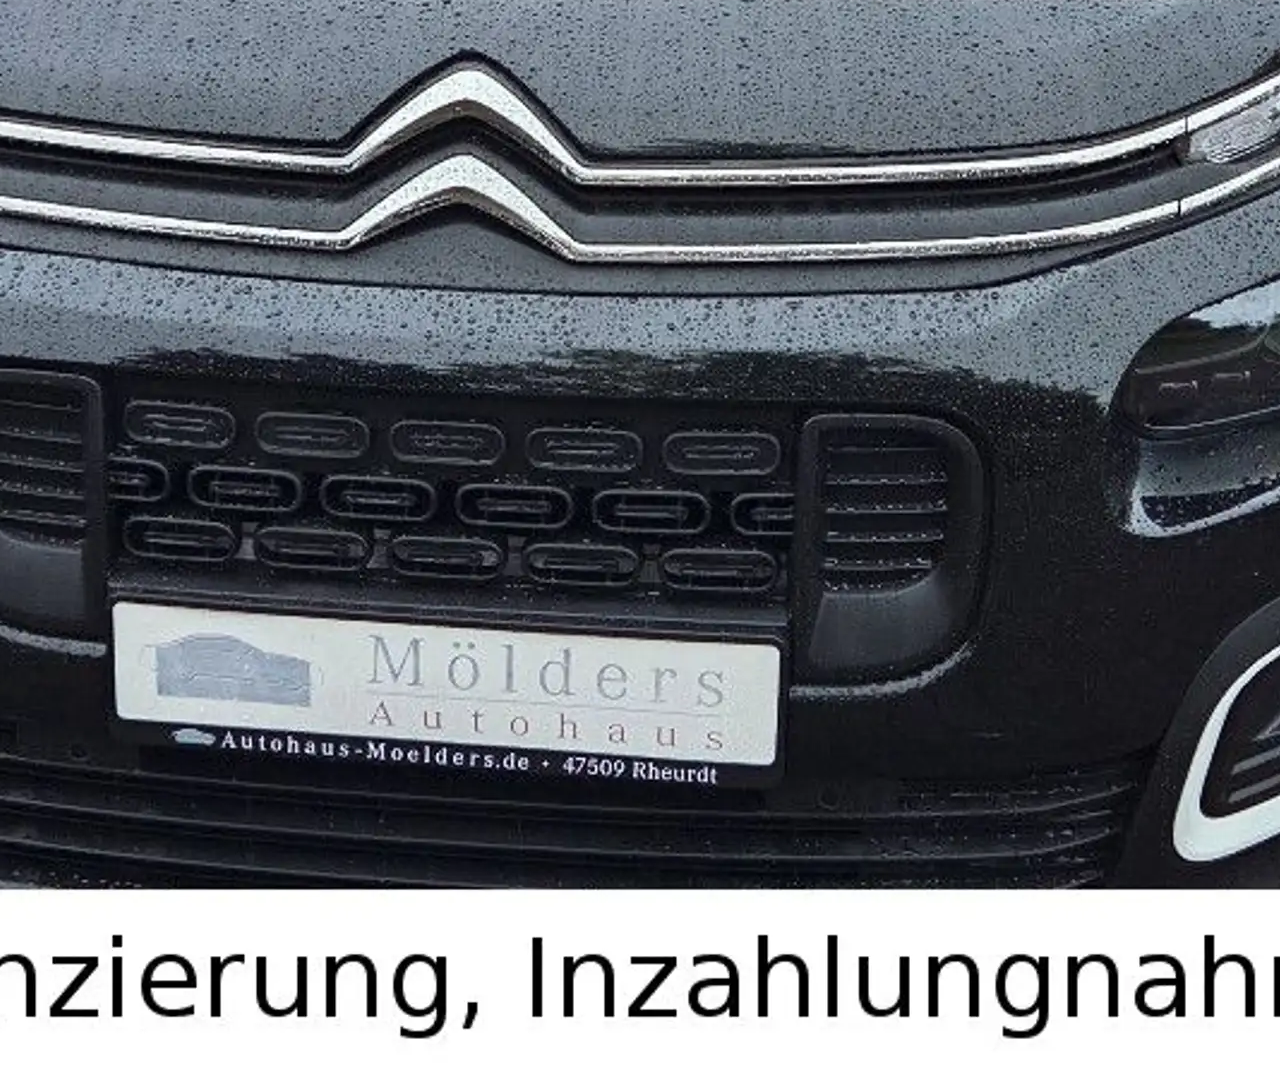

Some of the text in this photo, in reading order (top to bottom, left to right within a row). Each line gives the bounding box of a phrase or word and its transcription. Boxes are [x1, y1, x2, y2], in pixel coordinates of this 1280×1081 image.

[366, 633, 725, 708] Mölders
[368, 700, 724, 752] Autohaus
[221, 730, 719, 785] Autohaus-Moelders.de 47509 Rheurdt
